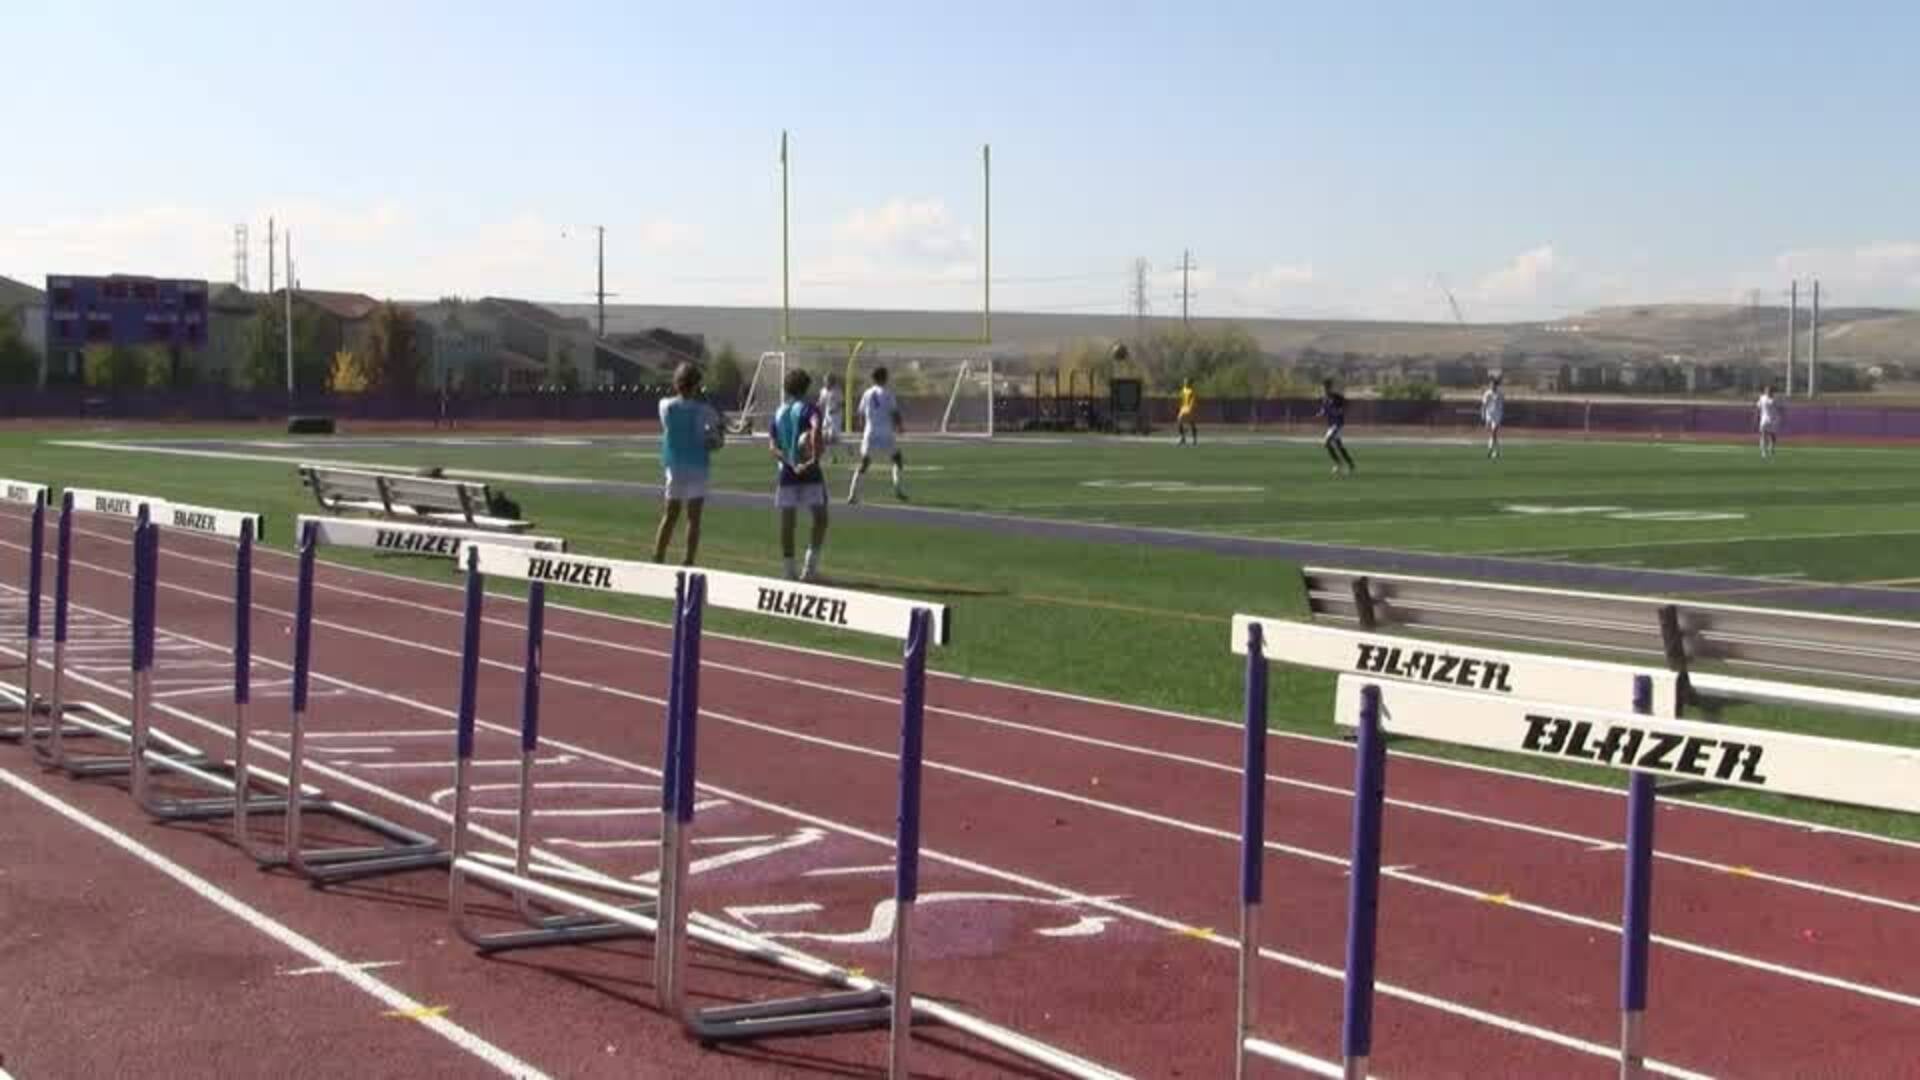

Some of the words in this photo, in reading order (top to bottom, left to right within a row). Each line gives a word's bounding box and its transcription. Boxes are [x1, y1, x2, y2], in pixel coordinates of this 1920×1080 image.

[174, 510, 216, 531] BLAZER
[528, 557, 611, 588] BLAZER
[758, 587, 847, 625] BLAZER
[1356, 643, 1512, 692] BLAZER
[1522, 714, 1766, 785] BLAZER
